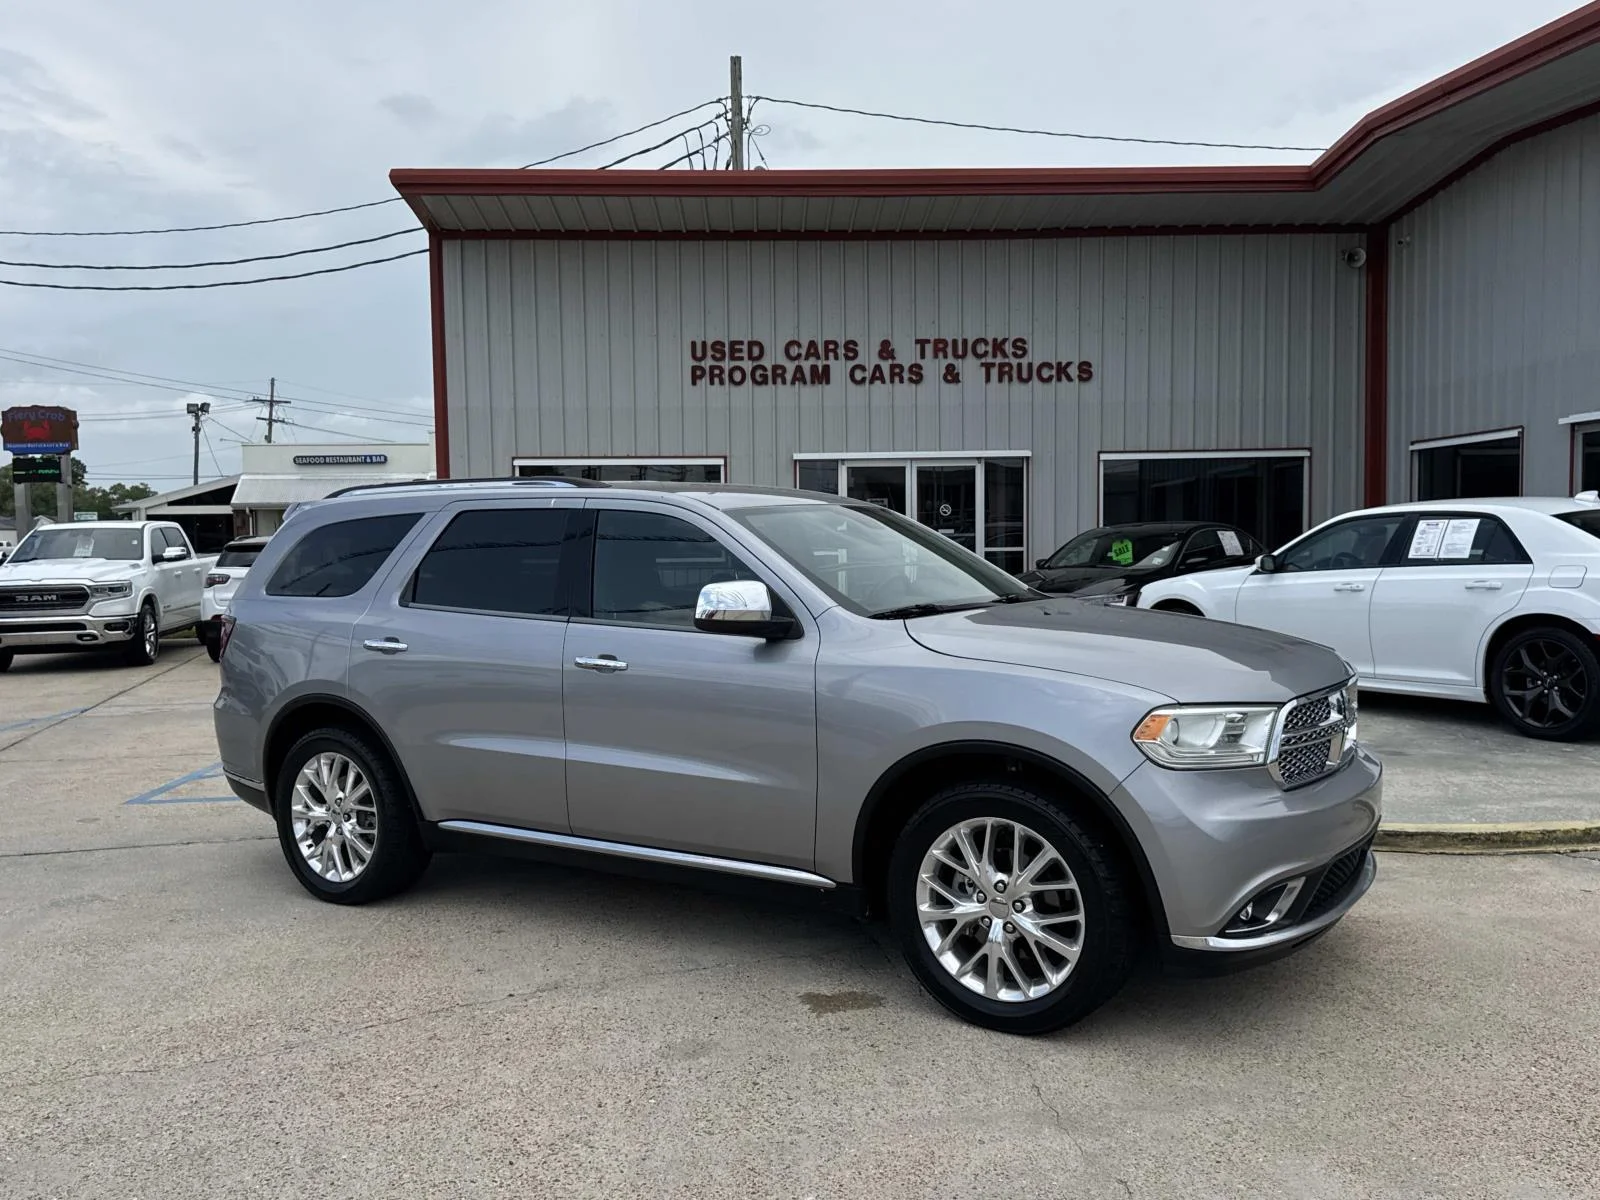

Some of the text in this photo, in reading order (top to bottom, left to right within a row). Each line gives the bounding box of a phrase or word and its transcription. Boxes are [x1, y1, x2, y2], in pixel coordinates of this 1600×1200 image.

[690, 338, 1028, 361] USED CARS & TRUCKS
[691, 361, 1093, 386] PROGRAM CARS & TRUCKS
[1114, 544, 1129, 556] SALE
